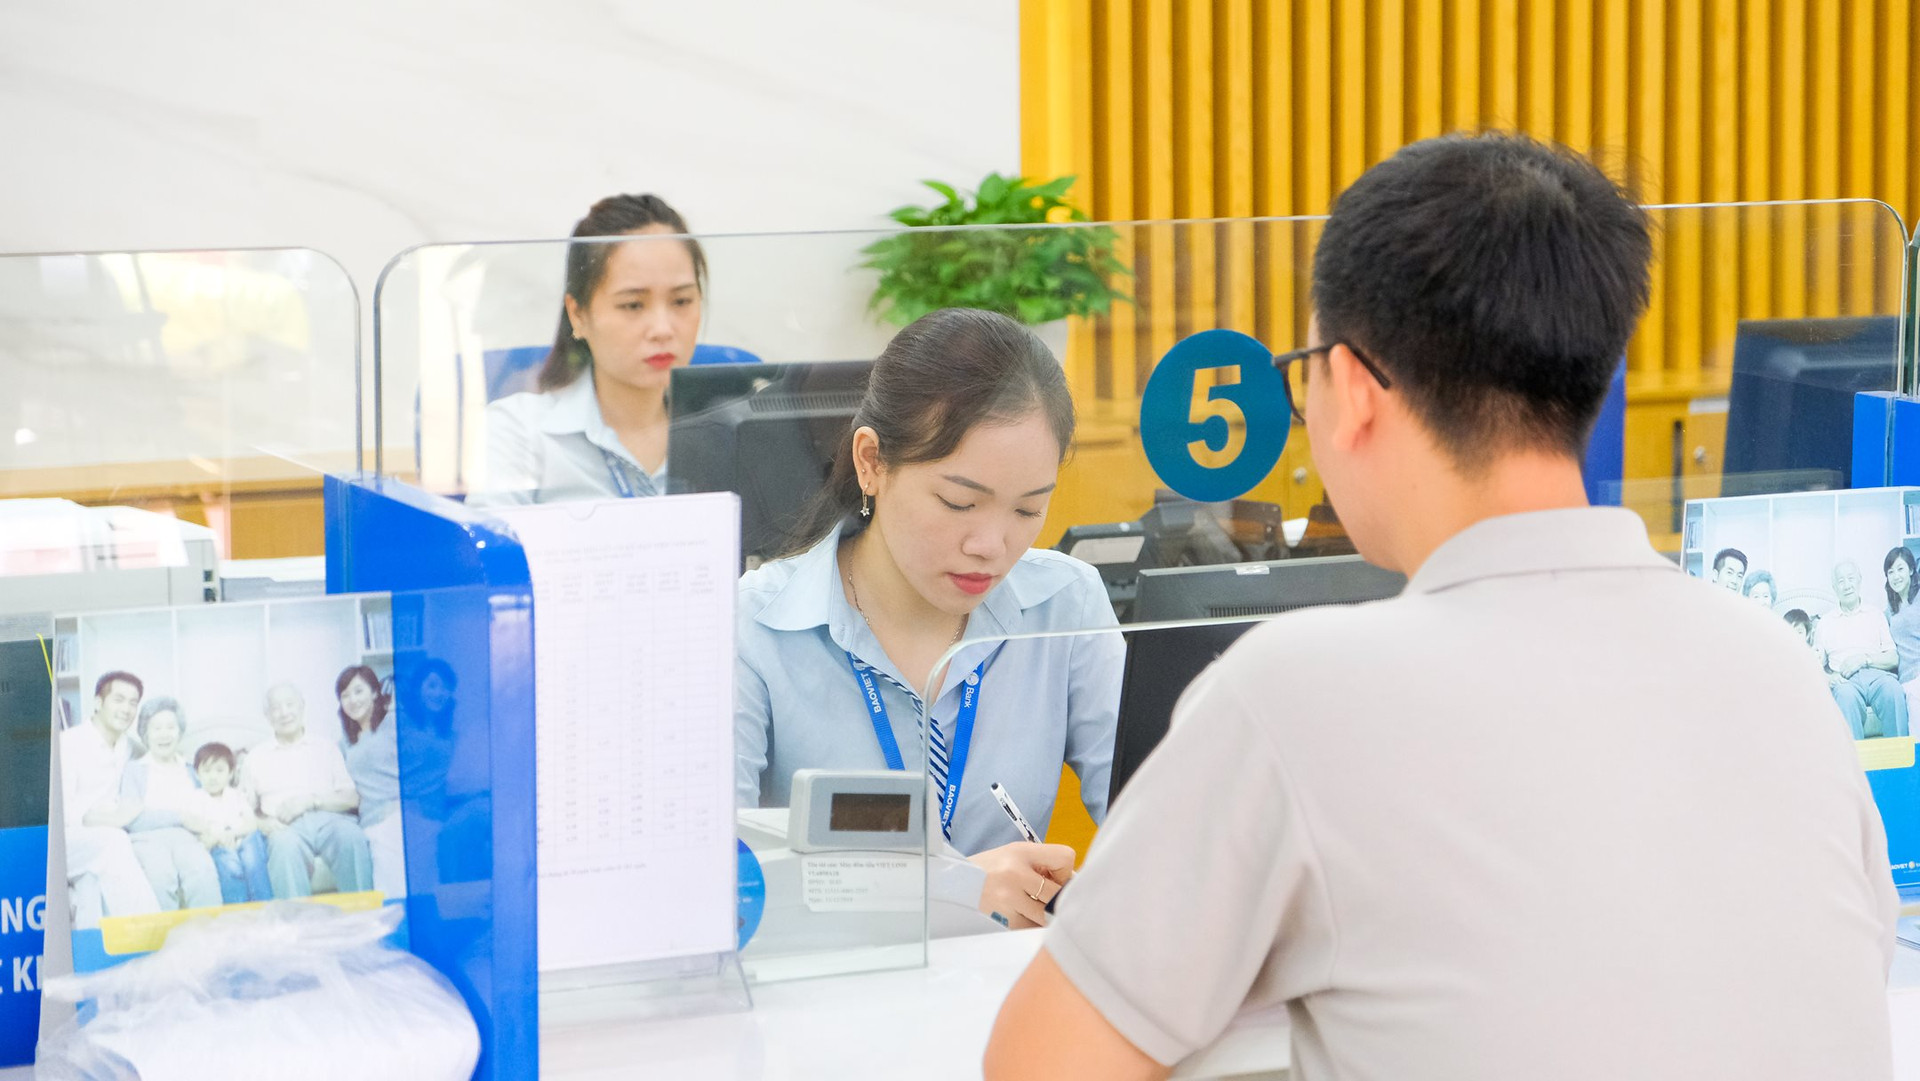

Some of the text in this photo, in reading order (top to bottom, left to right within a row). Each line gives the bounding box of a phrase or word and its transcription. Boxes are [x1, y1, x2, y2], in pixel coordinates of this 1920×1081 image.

[1187, 364, 1247, 469] 5
[860, 672, 882, 714] BAOVIET
[963, 686, 975, 709] Bank
[941, 783, 956, 827] BAOVIET
[1, 895, 46, 934] NG
